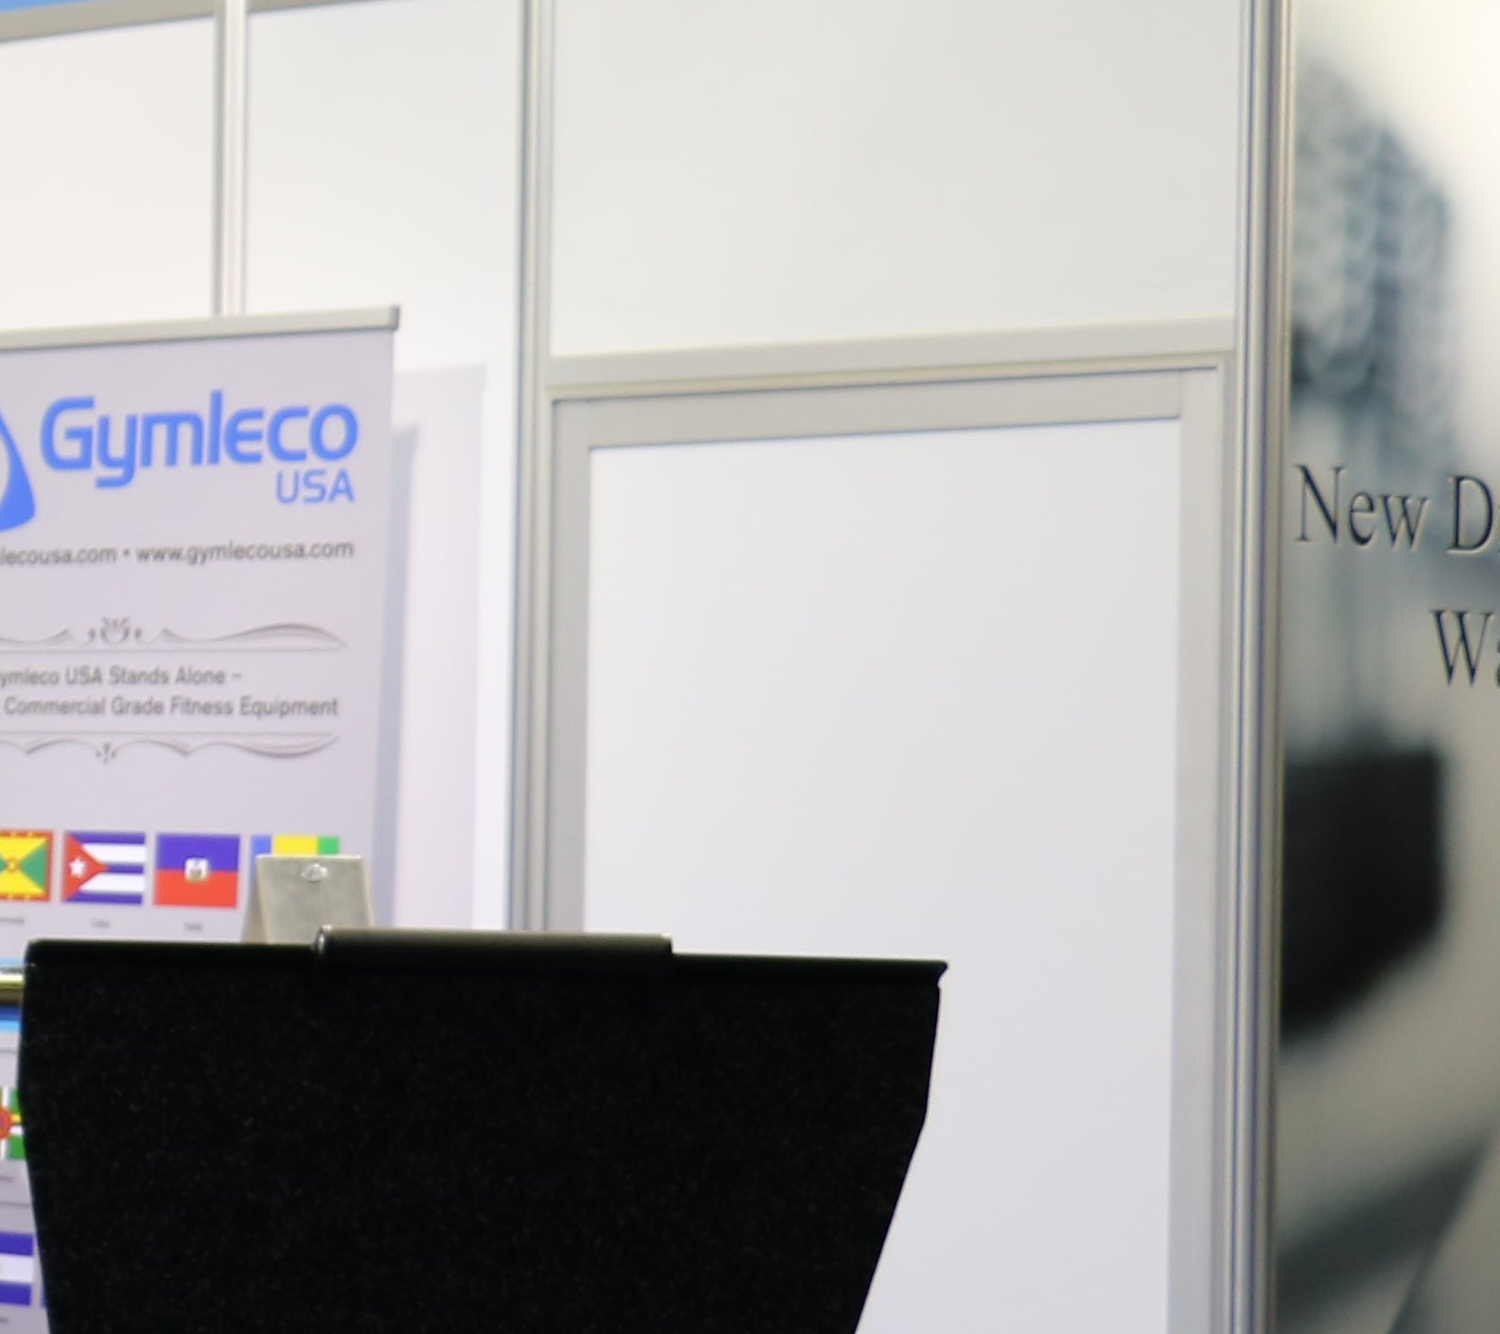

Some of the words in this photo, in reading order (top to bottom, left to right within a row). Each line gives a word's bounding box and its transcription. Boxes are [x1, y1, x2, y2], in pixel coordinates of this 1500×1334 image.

[40, 390, 358, 489] Gymleco
[276, 469, 356, 504] USA
[1296, 464, 1428, 551] New
[1447, 473, 1500, 554] D
[135, 540, 355, 566] www.gymlecousa.com
[1431, 608, 1500, 688] W
[64, 665, 104, 686] USA
[108, 664, 170, 686] Stands
[175, 664, 226, 685] Alone
[3, 695, 106, 716] Commercial
[111, 695, 165, 716] Grade
[169, 695, 234, 716] Fitness
[240, 695, 339, 719] Equipment
